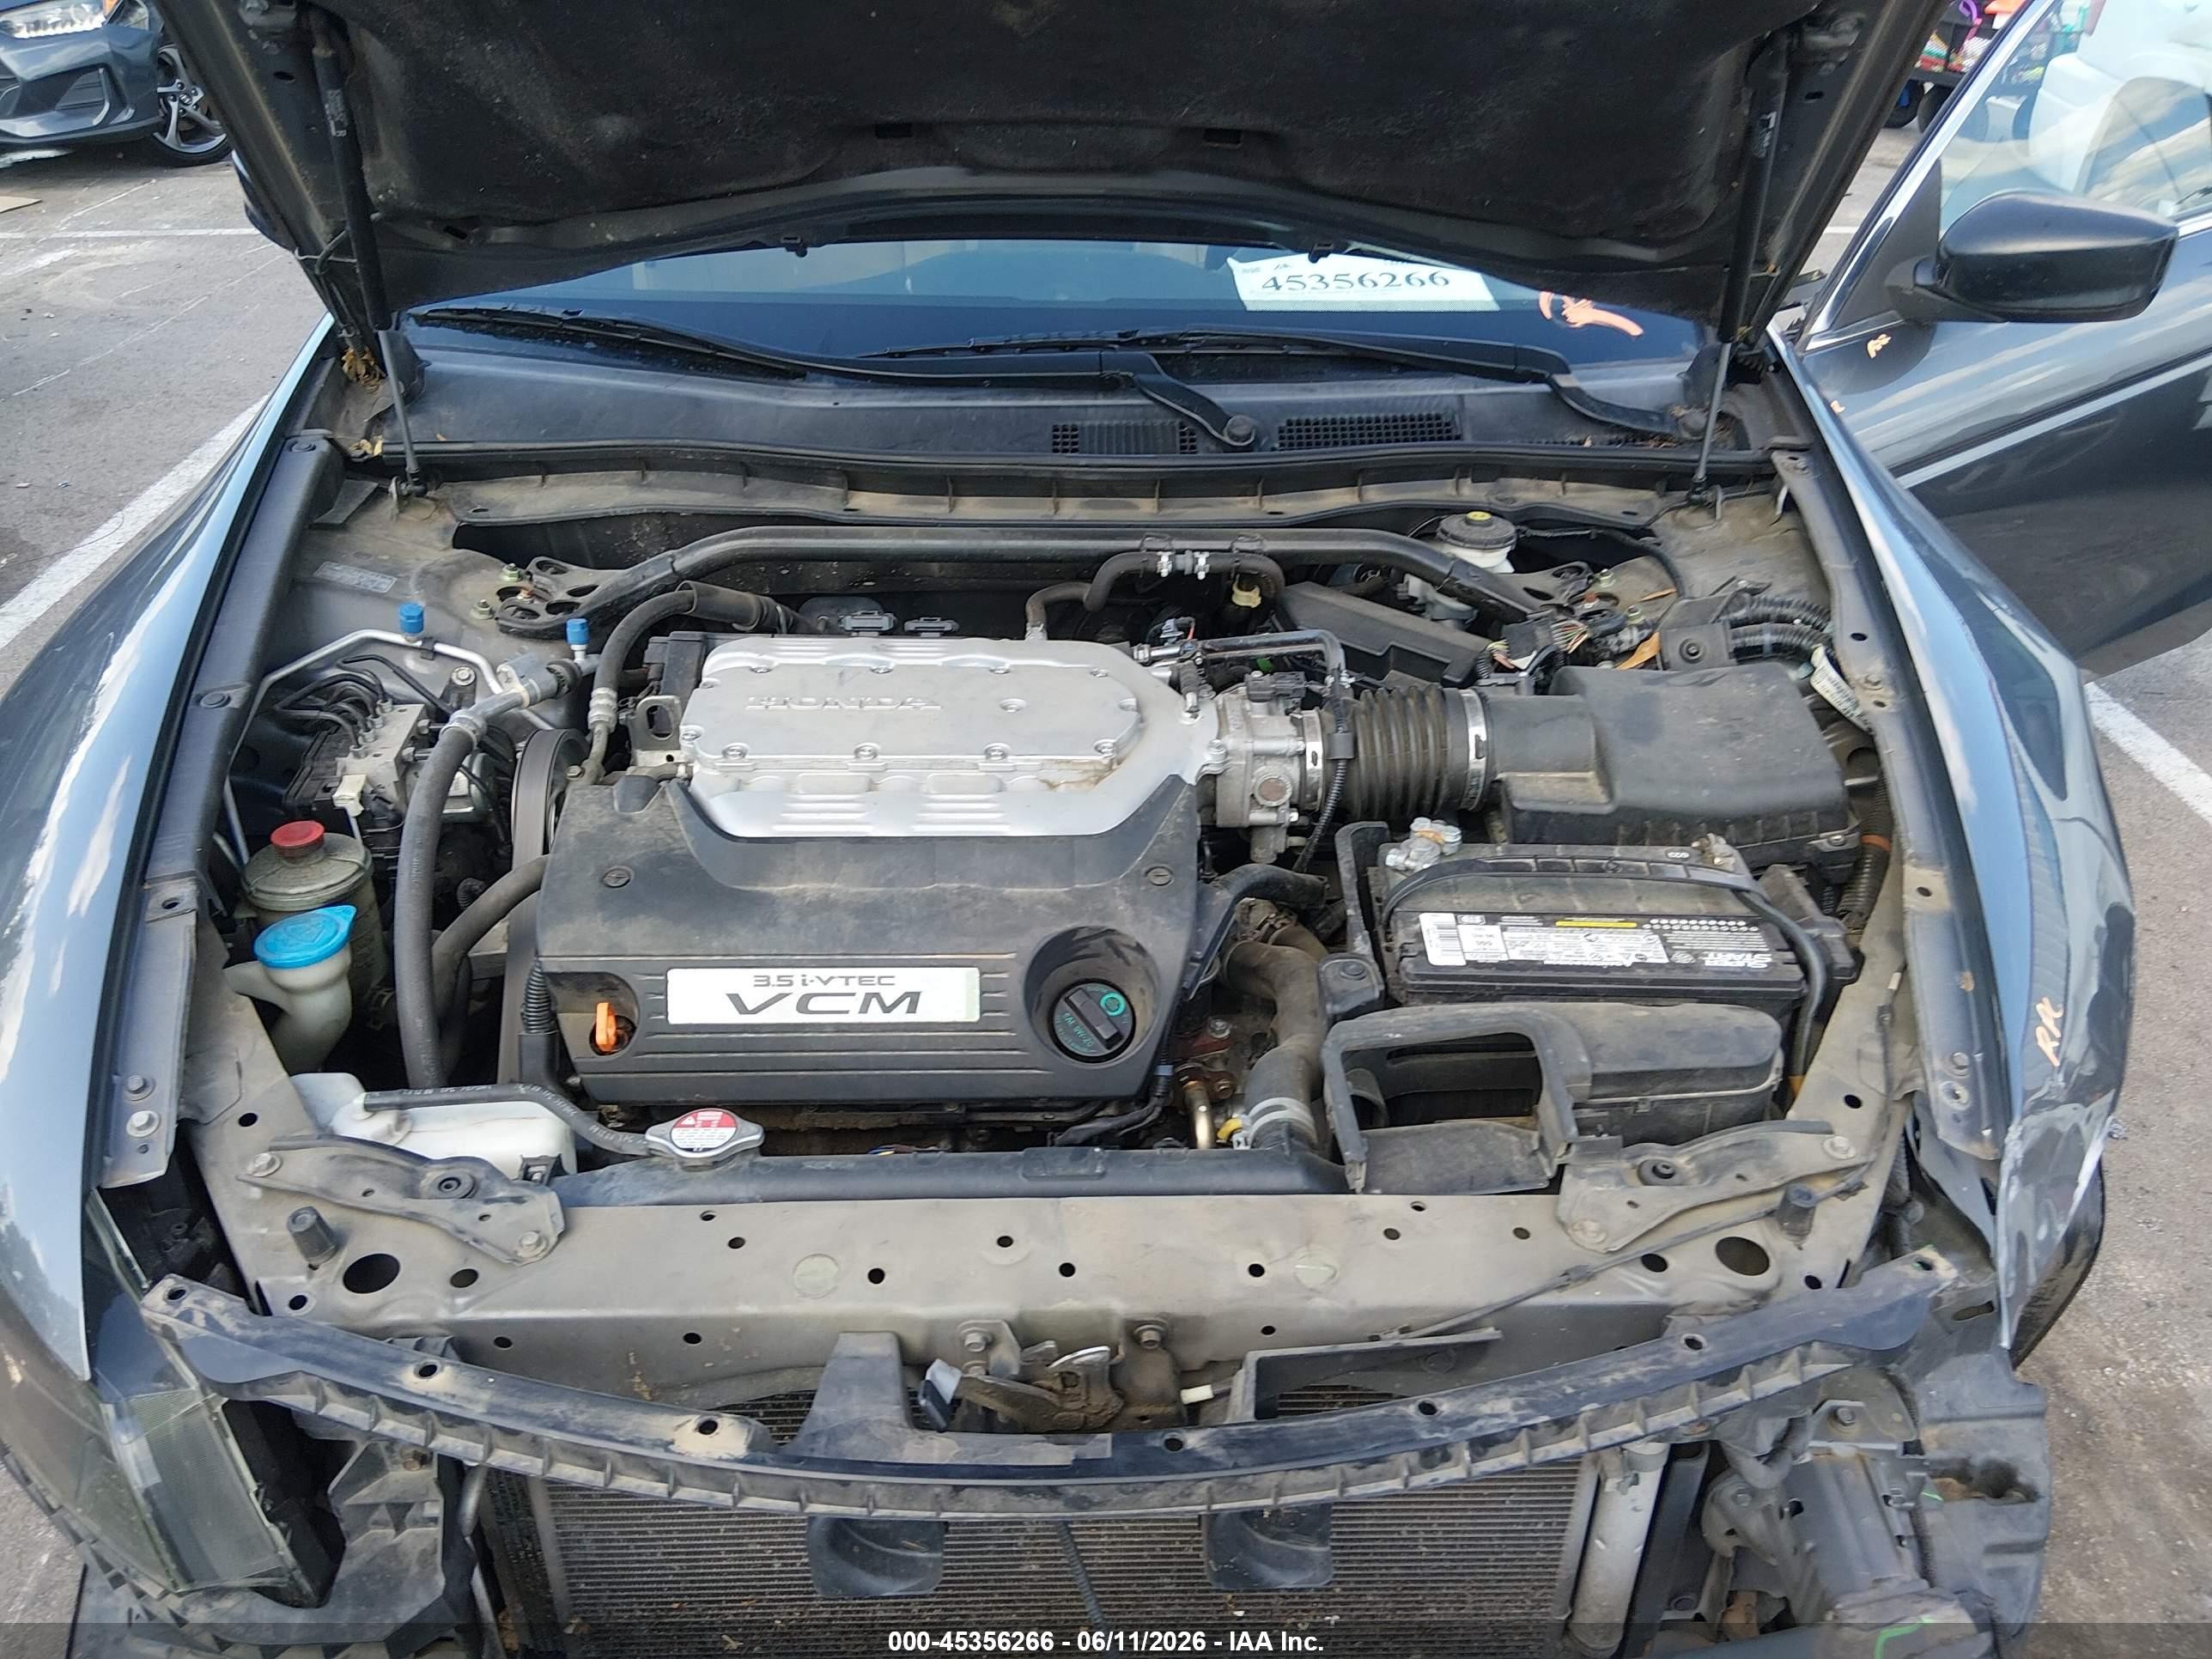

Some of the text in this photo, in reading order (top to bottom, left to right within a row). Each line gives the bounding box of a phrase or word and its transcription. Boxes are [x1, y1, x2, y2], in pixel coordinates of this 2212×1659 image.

[1261, 270, 1449, 292] 45356266
[744, 696, 943, 711] HONDA
[753, 975, 794, 988] 3.5
[726, 991, 922, 1015] VCM
